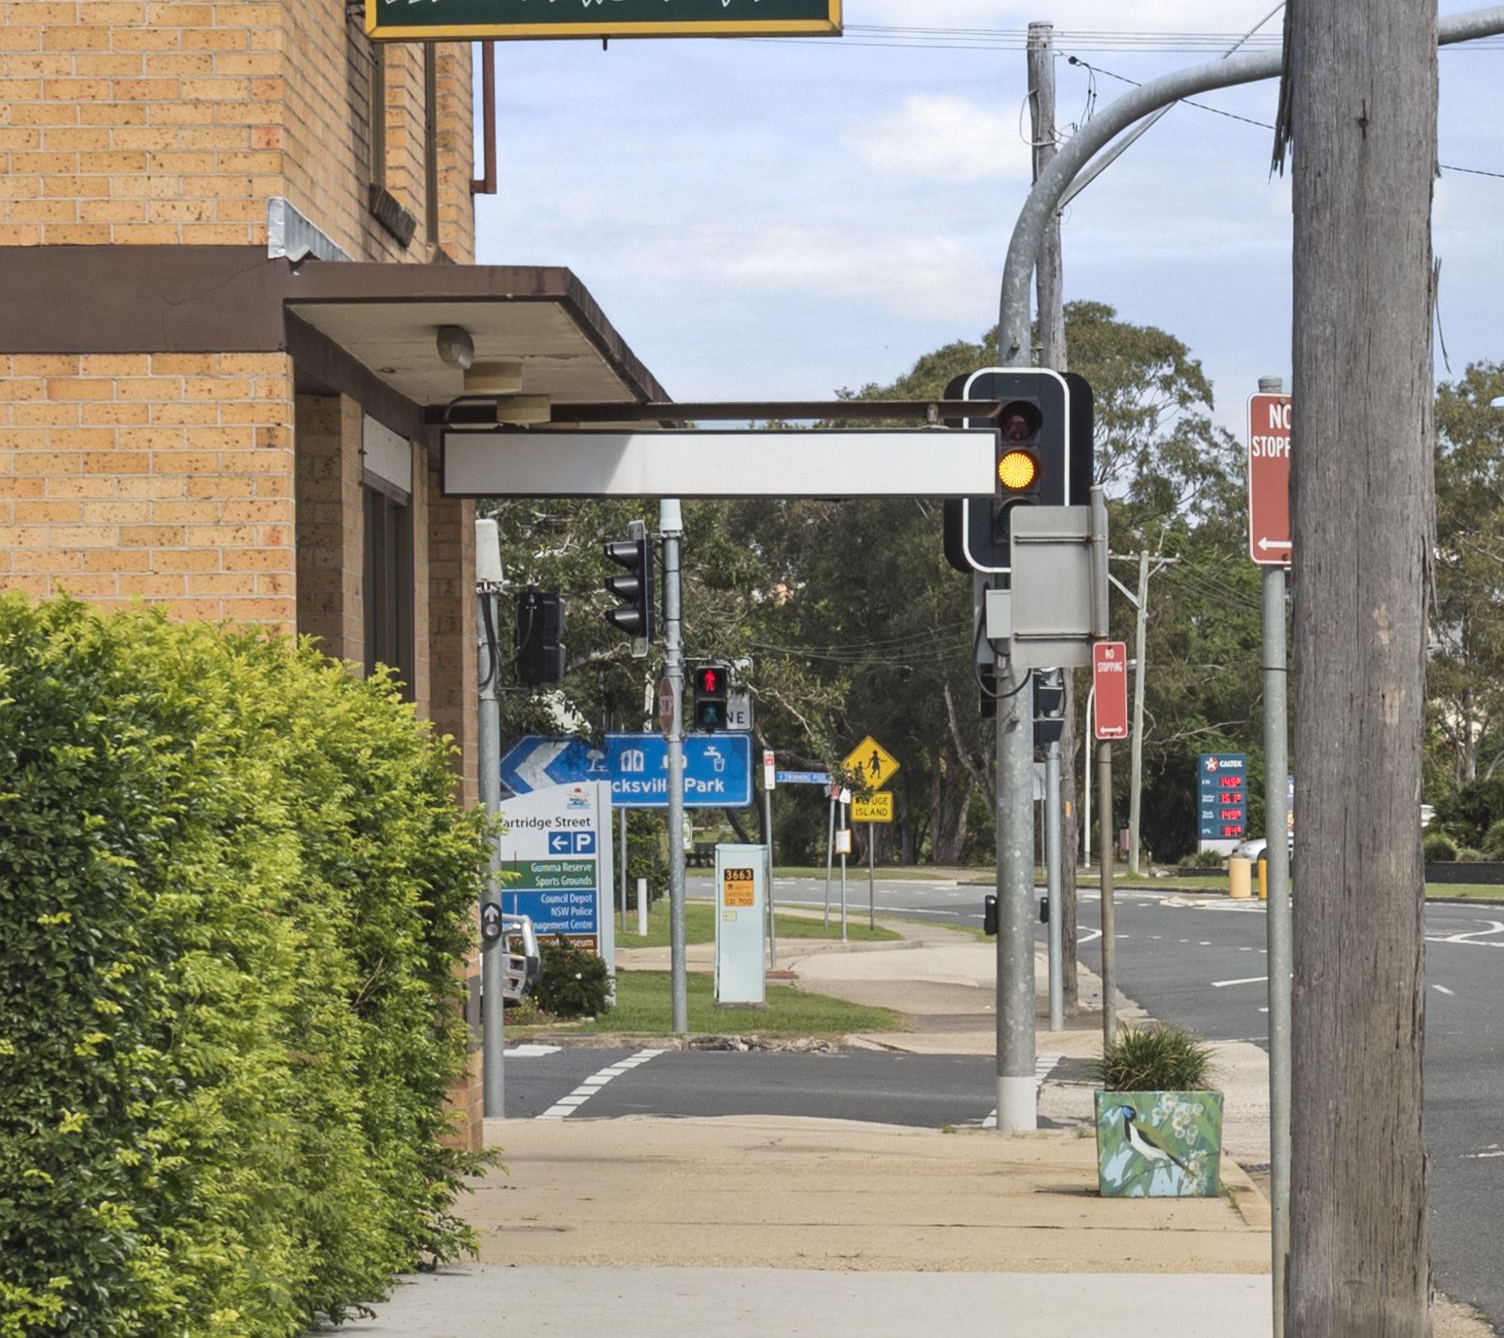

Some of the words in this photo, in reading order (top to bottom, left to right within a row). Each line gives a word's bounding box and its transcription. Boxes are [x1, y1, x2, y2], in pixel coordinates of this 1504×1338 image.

[1219, 760, 1243, 768] CALTEX
[612, 779, 668, 793] cksvill
[684, 778, 725, 793] Park
[856, 808, 888, 816] ISLAND
[501, 817, 552, 830] artridge
[555, 816, 591, 827] Street
[562, 862, 592, 872] Reserve
[726, 869, 752, 880] 3663
[535, 876, 560, 887] Sports
[561, 875, 592, 885] Grounds
[541, 893, 568, 903] Council
[570, 893, 592, 904] Depot
[551, 907, 569, 916] NSW
[571, 907, 592, 916] Police
[570, 919, 593, 930] Centre
